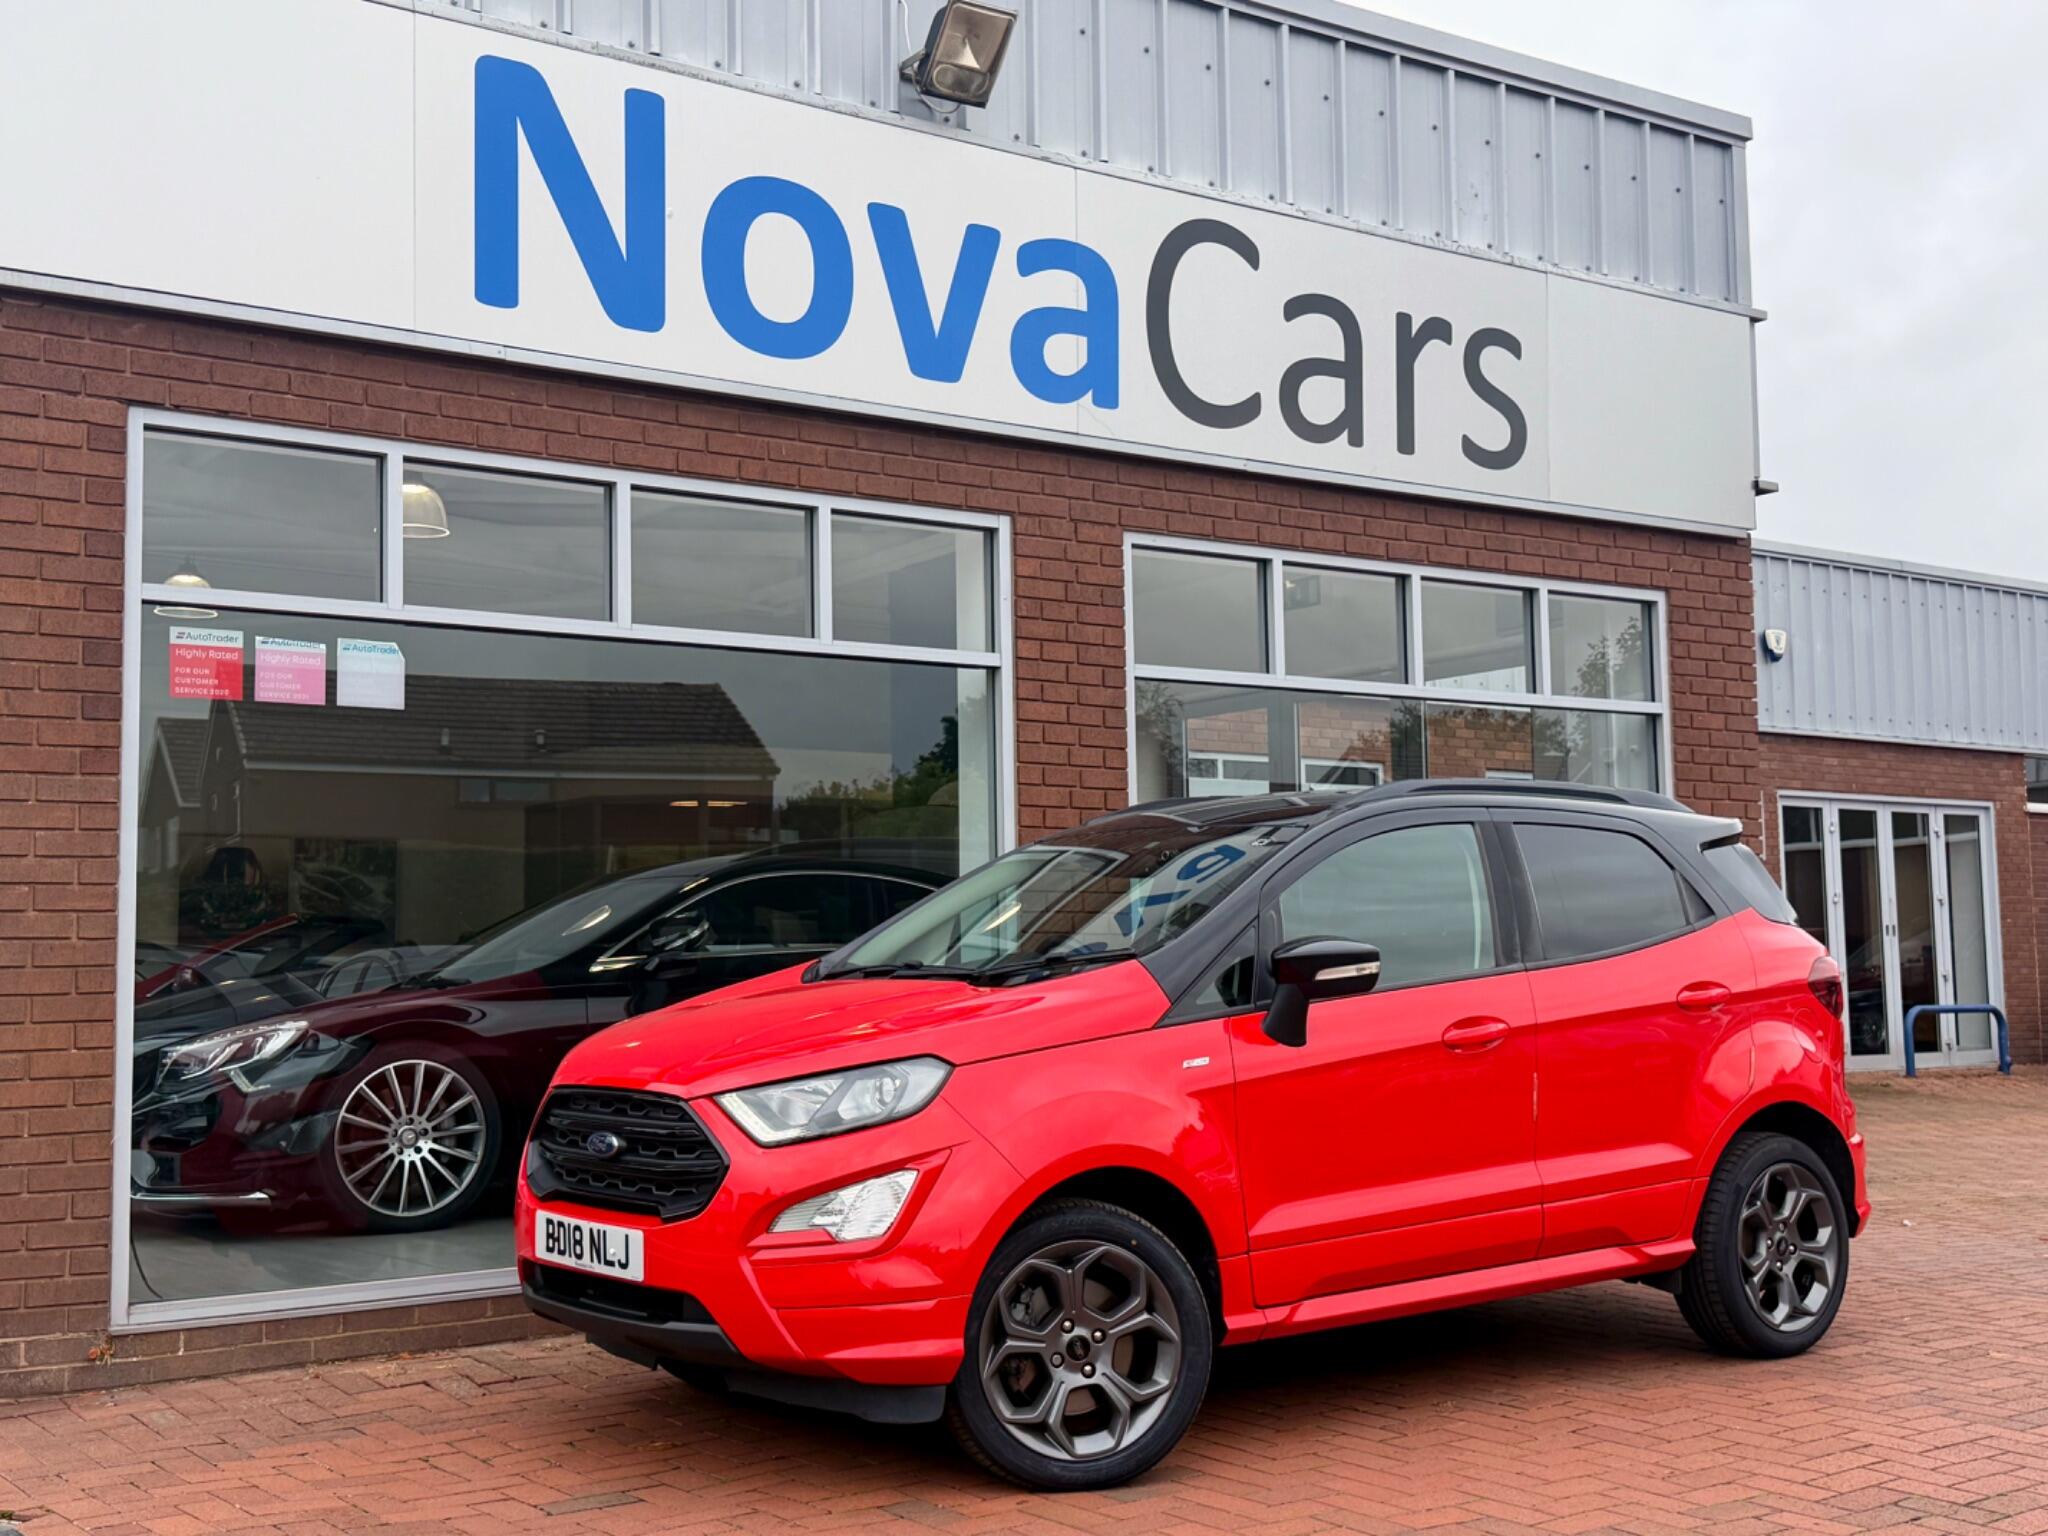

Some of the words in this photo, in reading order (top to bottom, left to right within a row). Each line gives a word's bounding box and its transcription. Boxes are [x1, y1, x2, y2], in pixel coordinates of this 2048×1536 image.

[186, 632, 239, 643] AutoTrader
[175, 648, 207, 660] Highly
[209, 650, 238, 660] Rated
[260, 652, 290, 665] Highly
[292, 655, 321, 665] Rated
[175, 666, 191, 674] FOR
[193, 667, 210, 675] OUR
[175, 677, 219, 686] CUSTOMER
[175, 687, 208, 695] SERVICE
[546, 1217, 583, 1260] BD18
[590, 1227, 629, 1270] NLJ
